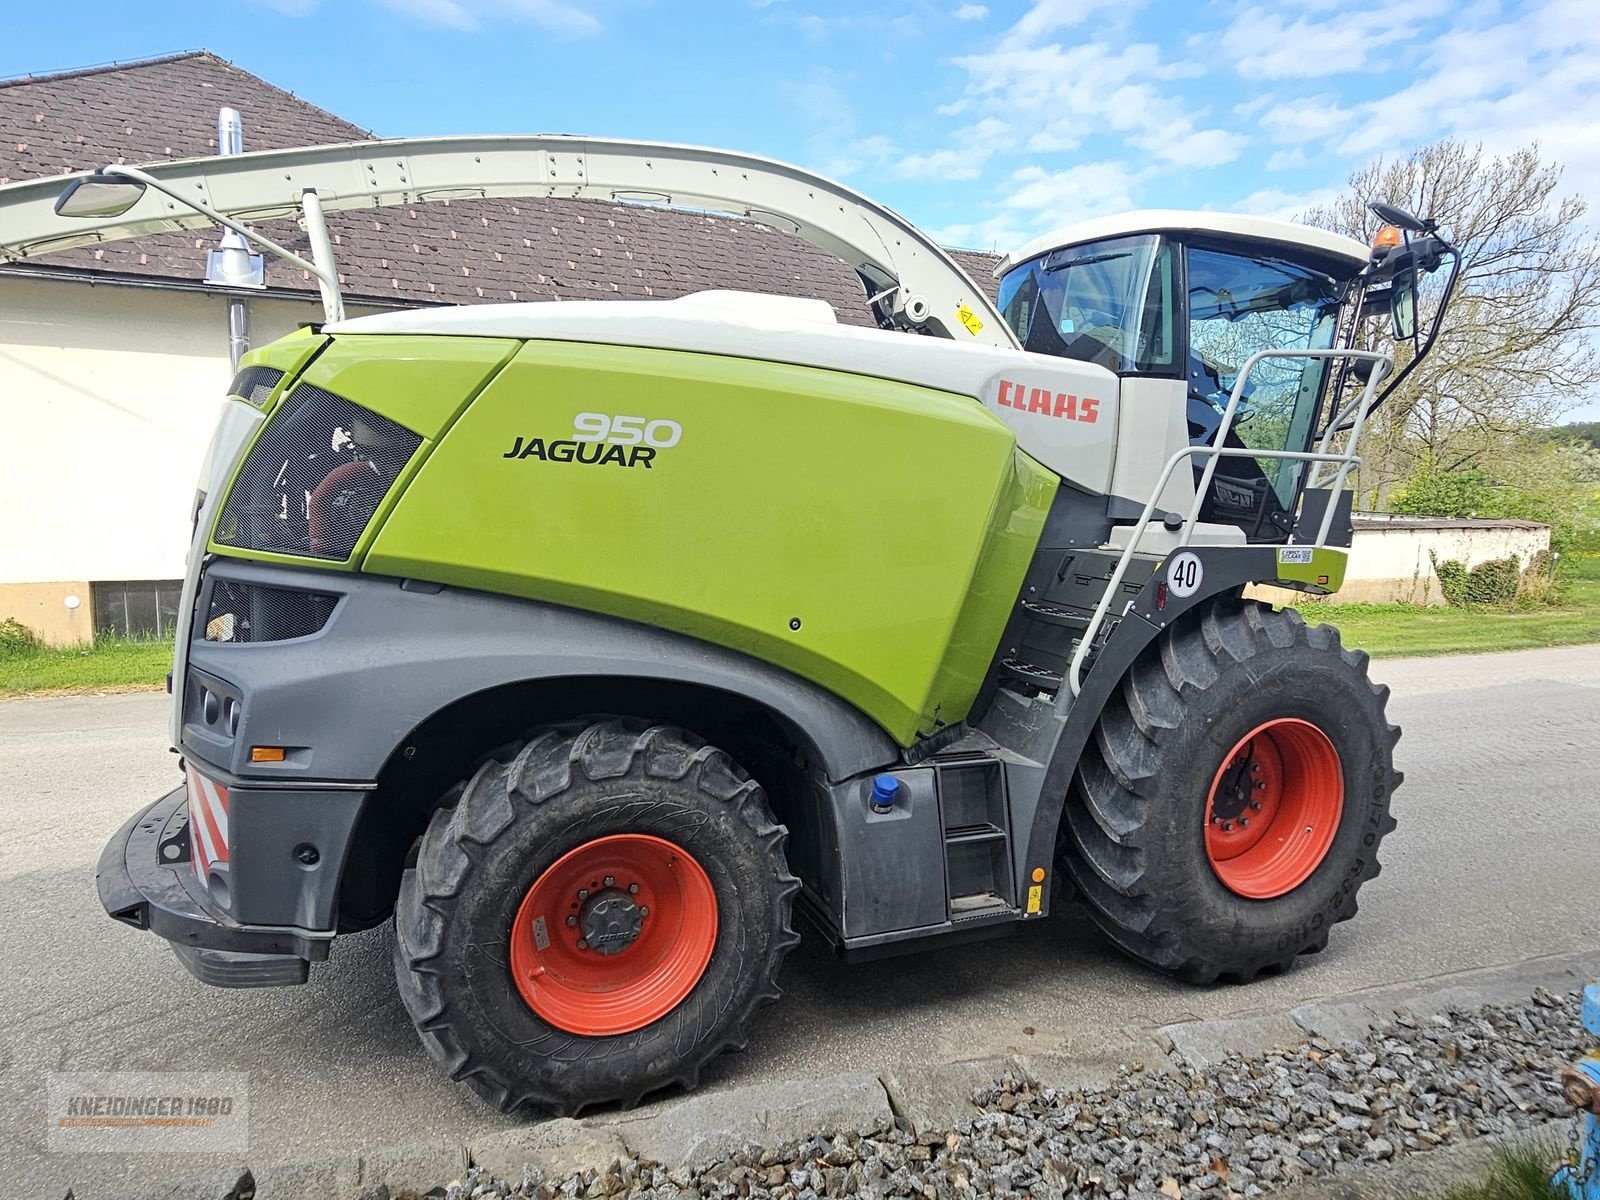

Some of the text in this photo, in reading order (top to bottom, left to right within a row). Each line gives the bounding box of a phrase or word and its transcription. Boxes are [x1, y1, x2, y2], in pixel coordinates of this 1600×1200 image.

[997, 379, 1100, 424] CLAAS
[572, 412, 682, 448] 950
[503, 436, 656, 469] JAGUAR
[1173, 560, 1197, 588] 40
